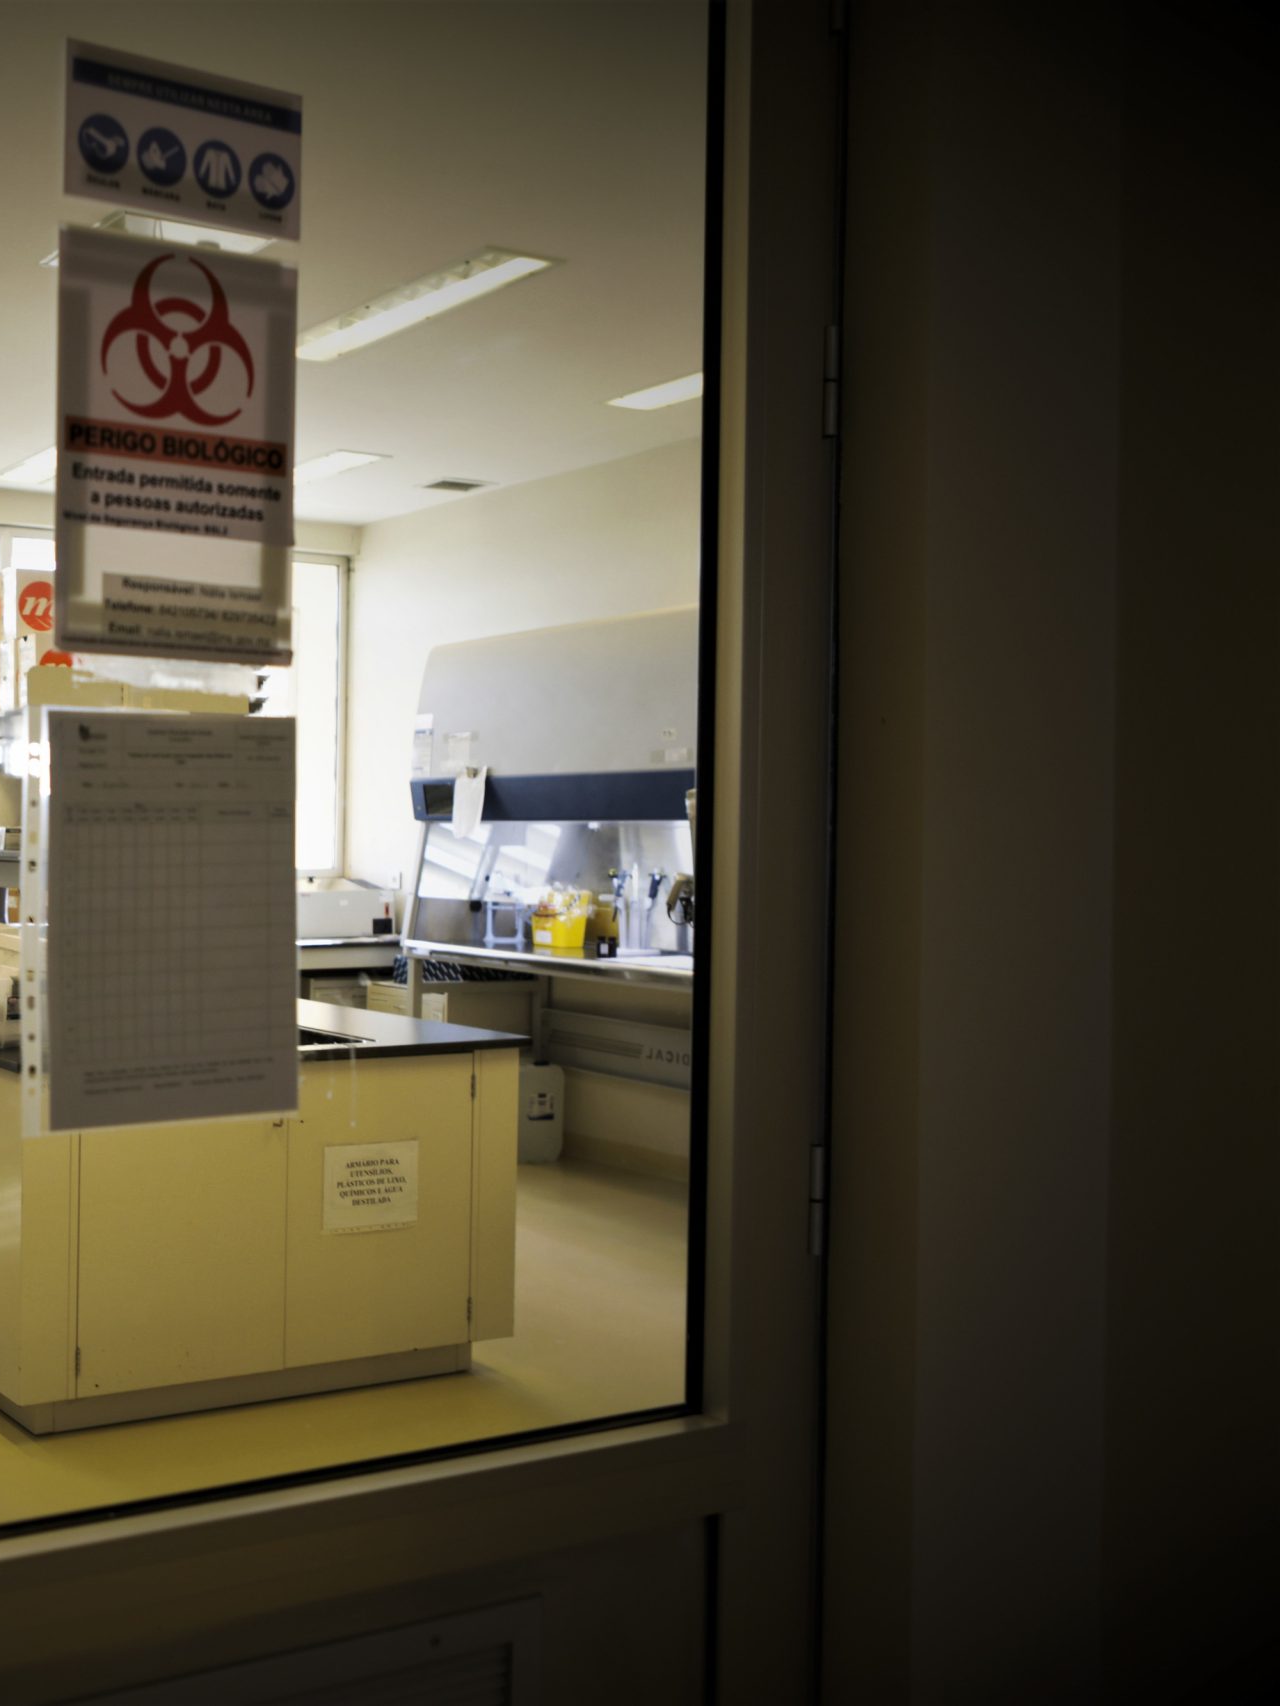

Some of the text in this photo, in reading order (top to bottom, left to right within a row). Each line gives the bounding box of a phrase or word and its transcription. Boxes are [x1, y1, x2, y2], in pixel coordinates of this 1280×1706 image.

[68, 424, 284, 469] PERIGO BIOLÓGICO
[72, 462, 281, 502] Entrada permitida somente
[90, 495, 264, 522] a pessoas autorizadas
[380, 1158, 400, 1166] PARA
